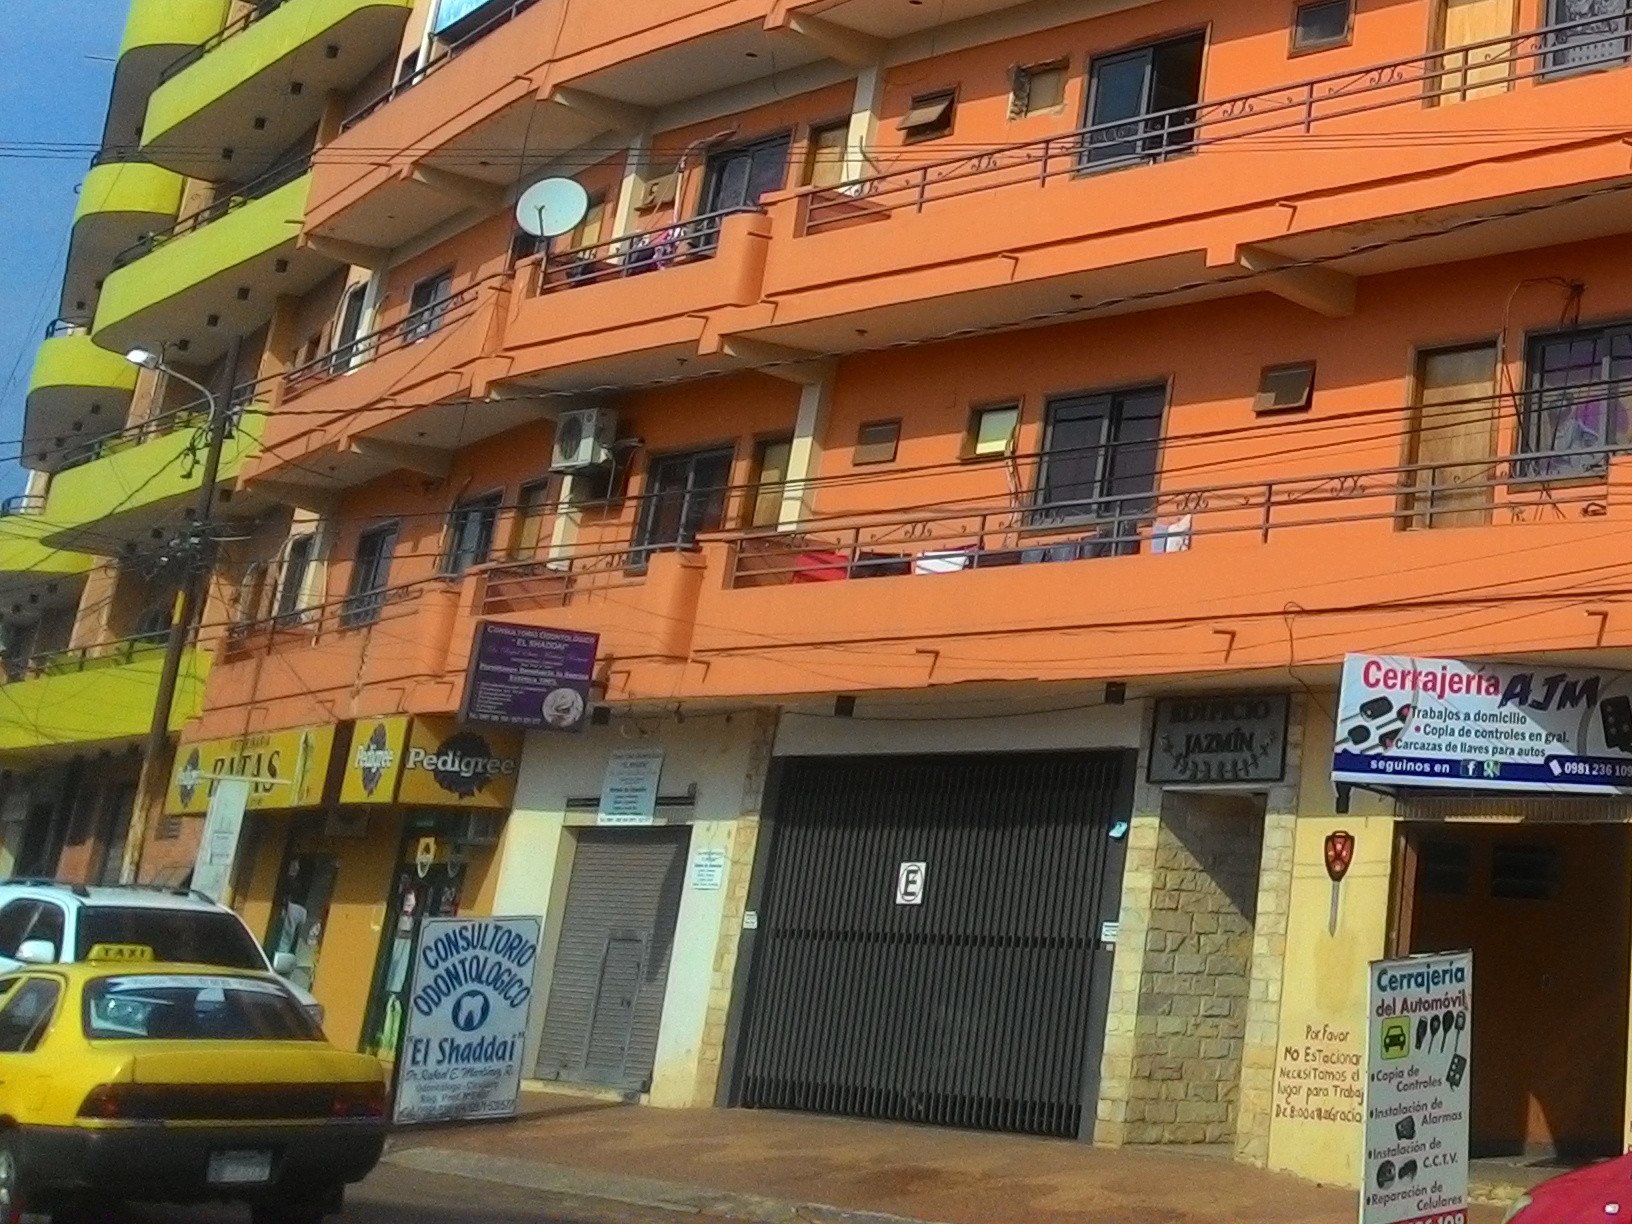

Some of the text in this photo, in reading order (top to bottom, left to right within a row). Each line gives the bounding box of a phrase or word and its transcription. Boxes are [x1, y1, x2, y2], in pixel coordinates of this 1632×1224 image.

[1363, 660, 1500, 700] Cerrajería
[1412, 705, 1527, 725] Trabajos a domicilio
[1423, 724, 1455, 738] Copia
[1458, 726, 1472, 738] de
[1474, 727, 1526, 741] controles
[1529, 732, 1543, 742] en
[1395, 739, 1546, 758] Carcazas de llaves para autos
[405, 747, 516, 778] Pedigree
[1370, 759, 1450, 774] seguinos en
[1565, 763, 1591, 775] 0981
[1592, 763, 1613, 776] 236
[901, 869, 920, 897] E
[103, 947, 146, 958] TAXI
[422, 923, 537, 970] CONSULTORIO
[413, 954, 531, 1017] ODONTOLOGICO
[1377, 961, 1465, 994] Cerrajería
[1375, 989, 1466, 1017] del Automóvil
[1305, 1024, 1320, 1040] Por
[1284, 1046, 1300, 1062] NO
[1376, 1065, 1420, 1083] Copia de
[1396, 1076, 1442, 1093] Controles
[1306, 1086, 1329, 1105] para
[1327, 1106, 1362, 1123] Gracia
[1374, 1097, 1443, 1119] Instalación de
[1421, 1111, 1463, 1127] Alarmas
[1373, 1137, 1442, 1160] Instalación de
[1423, 1152, 1458, 1168] C.C.T.V.
[1371, 1181, 1443, 1207] Reparación de
[1417, 1195, 1462, 1211] Celulares
